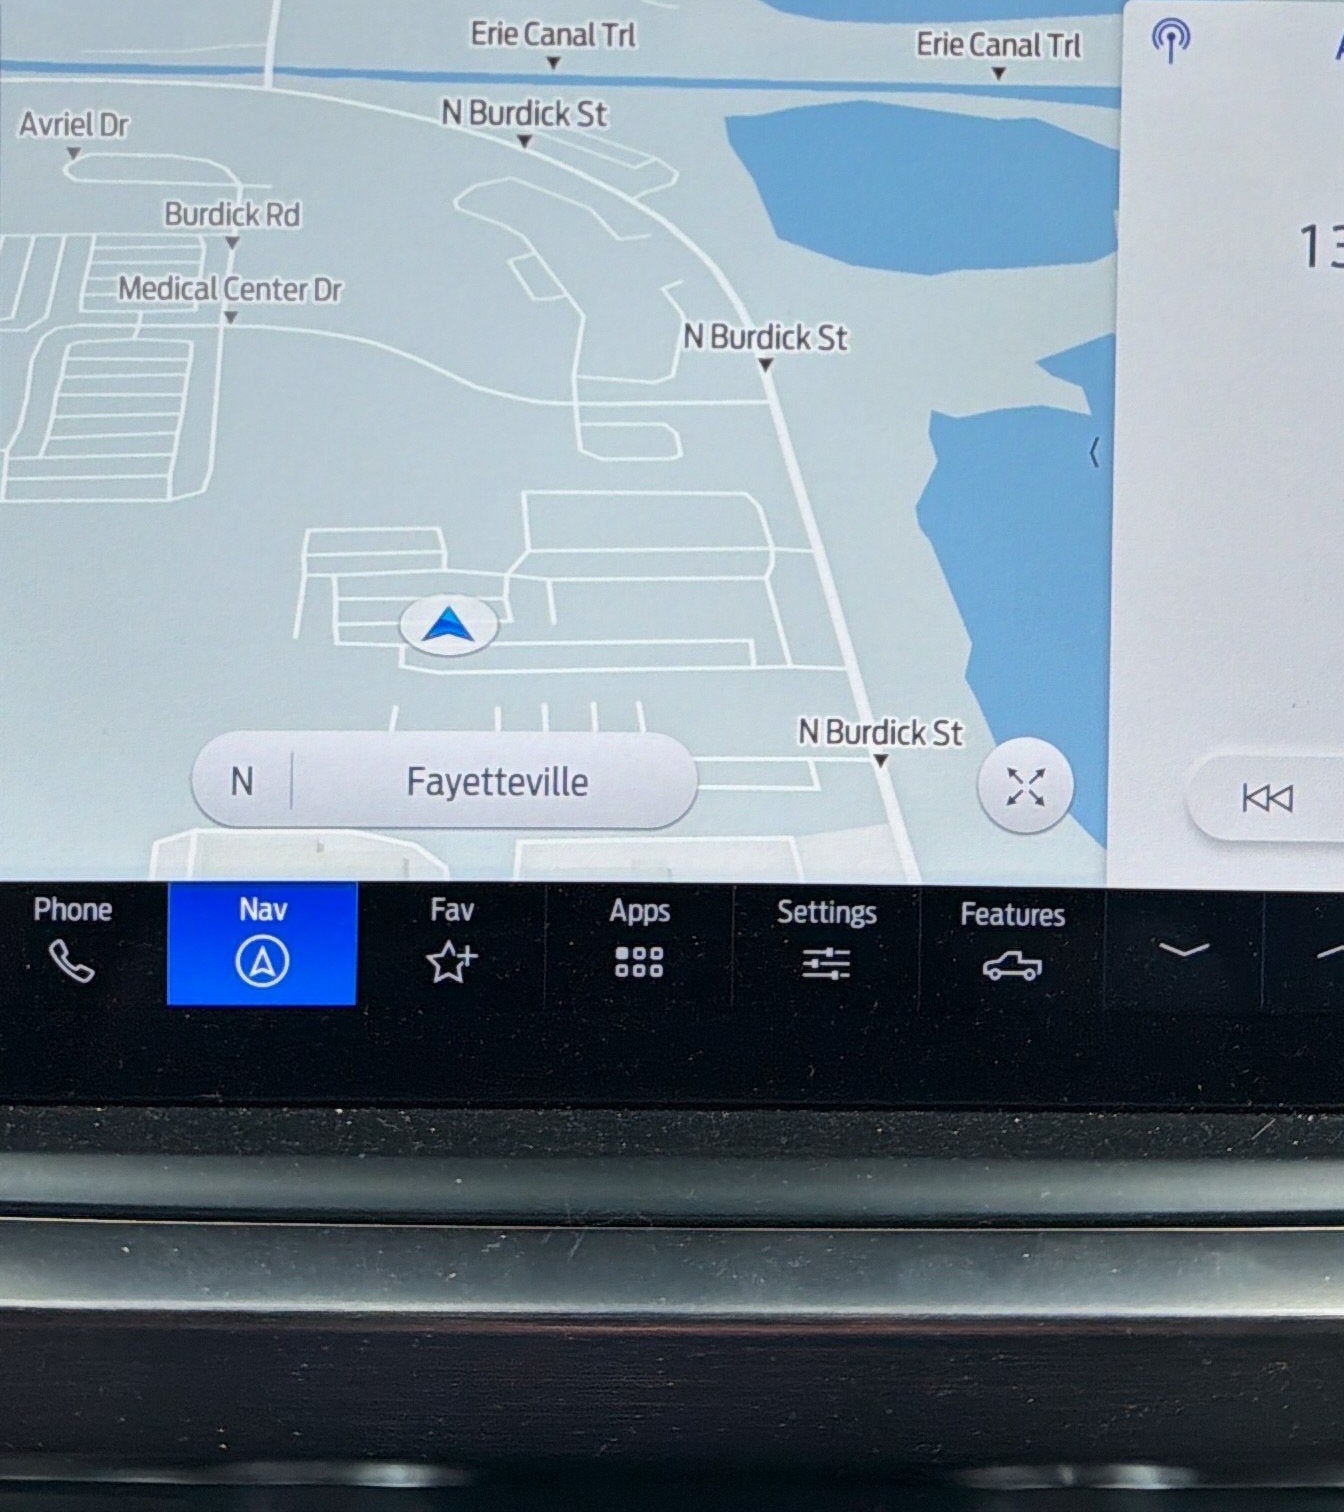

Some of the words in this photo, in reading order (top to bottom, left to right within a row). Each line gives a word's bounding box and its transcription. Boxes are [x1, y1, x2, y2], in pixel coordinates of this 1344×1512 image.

[472, 20, 519, 46] Erie
[524, 21, 595, 47] Canal
[601, 22, 635, 47] Trl
[918, 31, 964, 57] Erie
[969, 31, 1041, 57] Canal
[1047, 33, 1081, 58] Trl
[19, 111, 92, 137] Avriel
[100, 112, 129, 137] Dr
[442, 99, 462, 125] N
[470, 99, 570, 127] Burdick
[577, 100, 606, 127] St
[165, 201, 260, 227] Burdick
[266, 202, 300, 227] Rd
[119, 275, 217, 301] Medical
[223, 276, 308, 302] Center
[314, 277, 342, 302] Dr
[684, 323, 703, 349] N
[711, 323, 811, 350] Burdick
[818, 324, 848, 351] St
[799, 718, 819, 744] N
[827, 718, 926, 746] Burdick
[933, 719, 963, 746] St
[231, 766, 253, 796] N
[408, 765, 588, 802] Fayetteville
[34, 895, 113, 922] Phone
[240, 896, 288, 922] Nav
[431, 896, 475, 922] Fav
[609, 897, 671, 927] Apps
[777, 898, 878, 929] Settings
[961, 901, 1066, 927] Features
